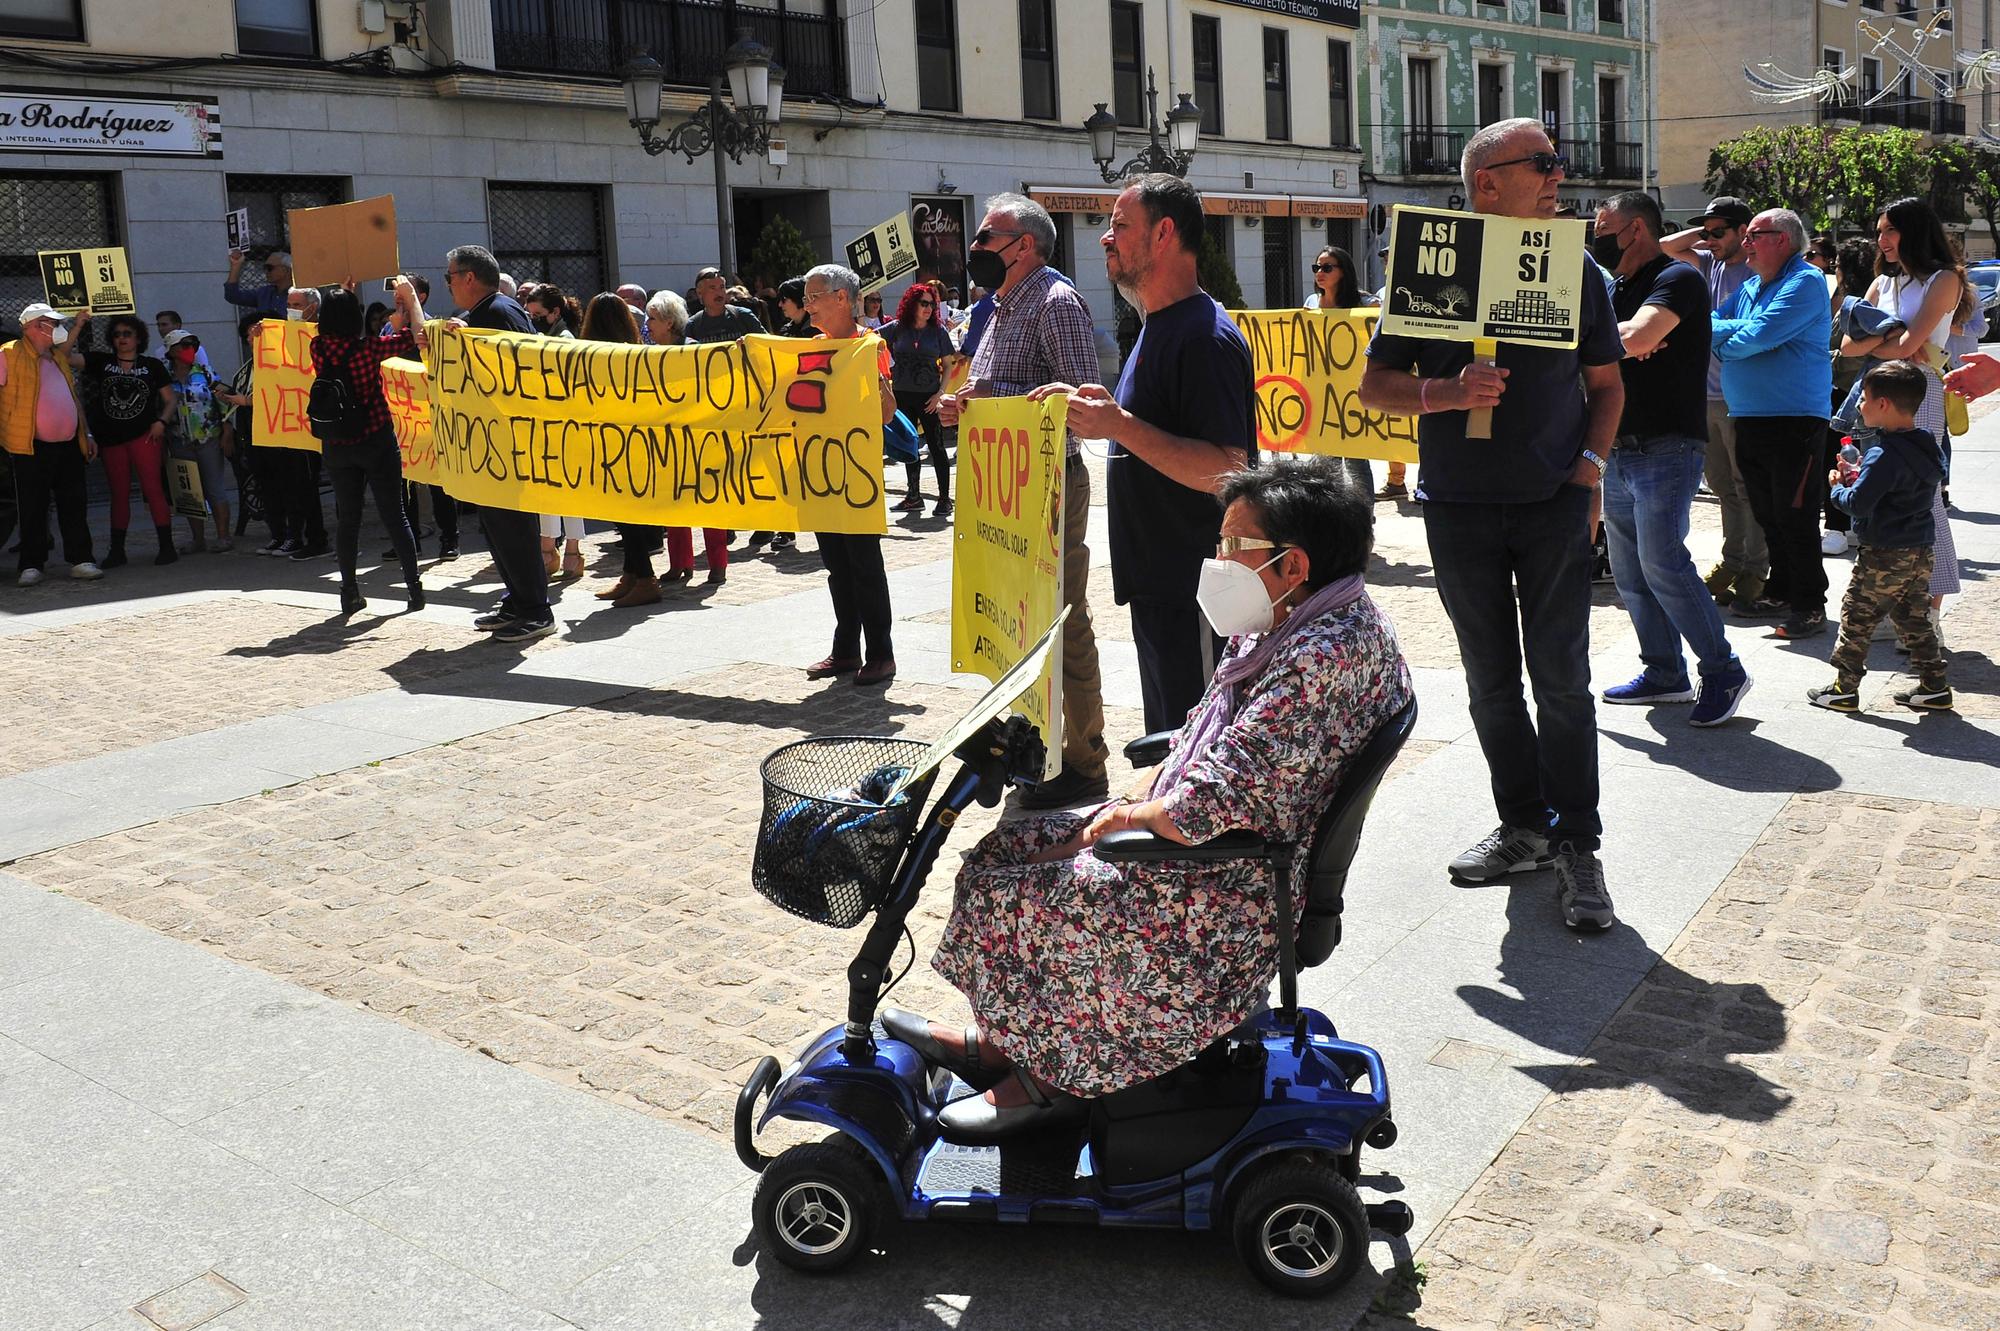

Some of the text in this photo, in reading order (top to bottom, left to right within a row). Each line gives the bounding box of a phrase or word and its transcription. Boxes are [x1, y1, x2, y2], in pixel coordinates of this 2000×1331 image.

[1239, 0, 1319, 17] QUITECTO TÉCNICO
[21, 103, 174, 139] Rodríguez
[6, 136, 57, 144] INTEGRAL,
[60, 137, 108, 145] PESTAÑAS
[1044, 196, 1101, 211] CAFETERIA
[1227, 200, 1268, 214] CAFETIN
[887, 222, 897, 235] ASÍ
[1419, 221, 1457, 244] ASÍ
[854, 238, 868, 254] ASÍ
[889, 231, 900, 249] SÍ
[1520, 229, 1551, 248] ASÍ
[53, 255, 71, 269] ASÍ
[97, 253, 112, 264] ASÍ
[856, 250, 872, 269] NO
[1416, 246, 1457, 277] NO
[1518, 250, 1551, 283] SÍ
[55, 269, 75, 286] NO
[99, 264, 115, 282] SÍ
[968, 427, 1030, 520] STOP
